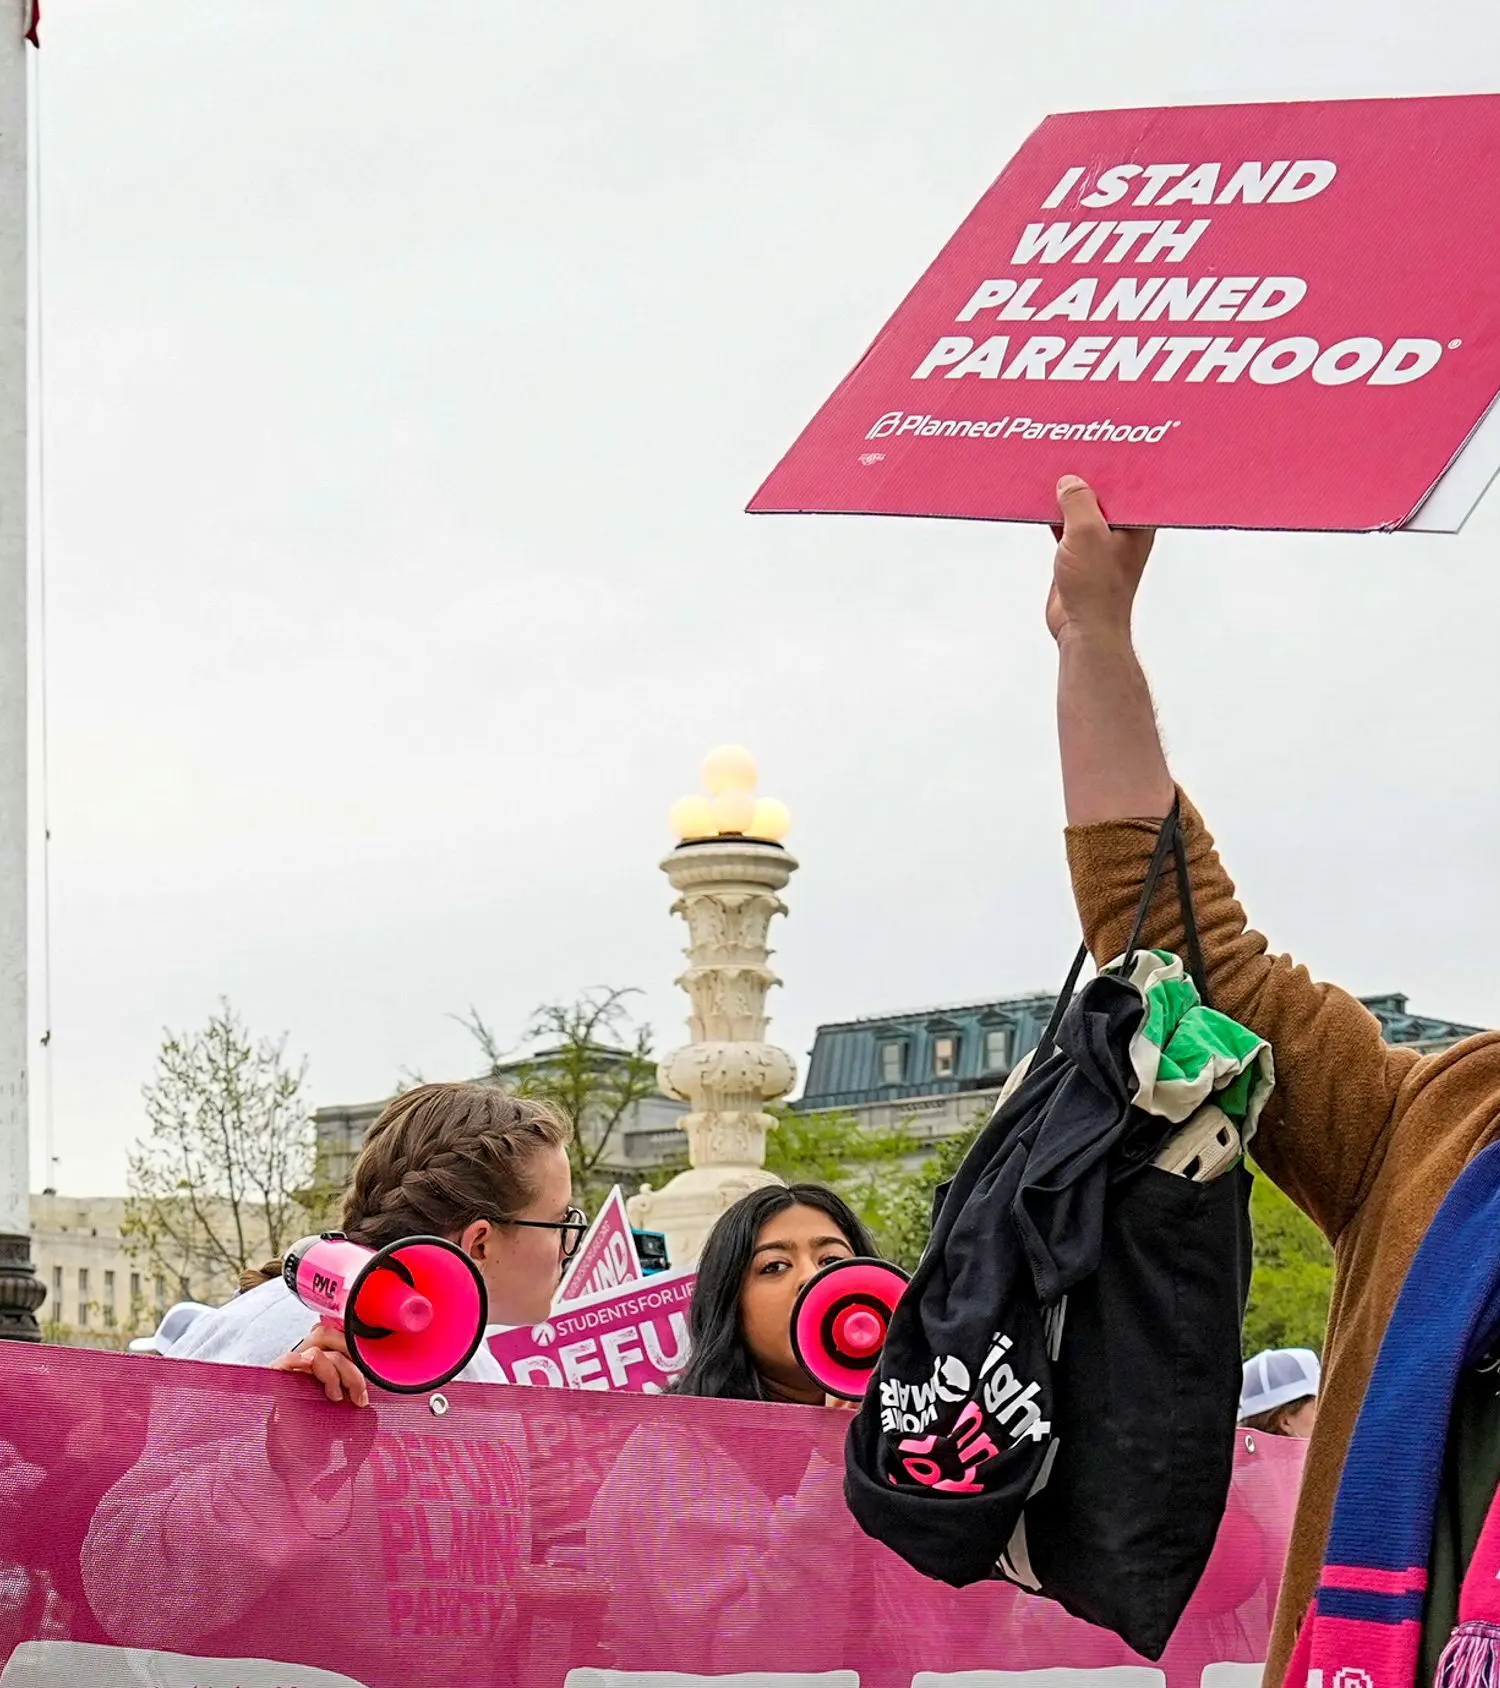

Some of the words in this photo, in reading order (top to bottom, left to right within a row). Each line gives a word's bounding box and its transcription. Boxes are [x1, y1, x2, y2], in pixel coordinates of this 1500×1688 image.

[1042, 166, 1085, 209] I
[1080, 159, 1337, 209] STAND
[1010, 219, 1210, 265] WITH
[955, 276, 1308, 323] PLANNED
[896, 414, 1010, 439] Planned
[555, 1281, 698, 1338] STUDENTSFORLIF
[511, 1310, 692, 1392] DEFU
